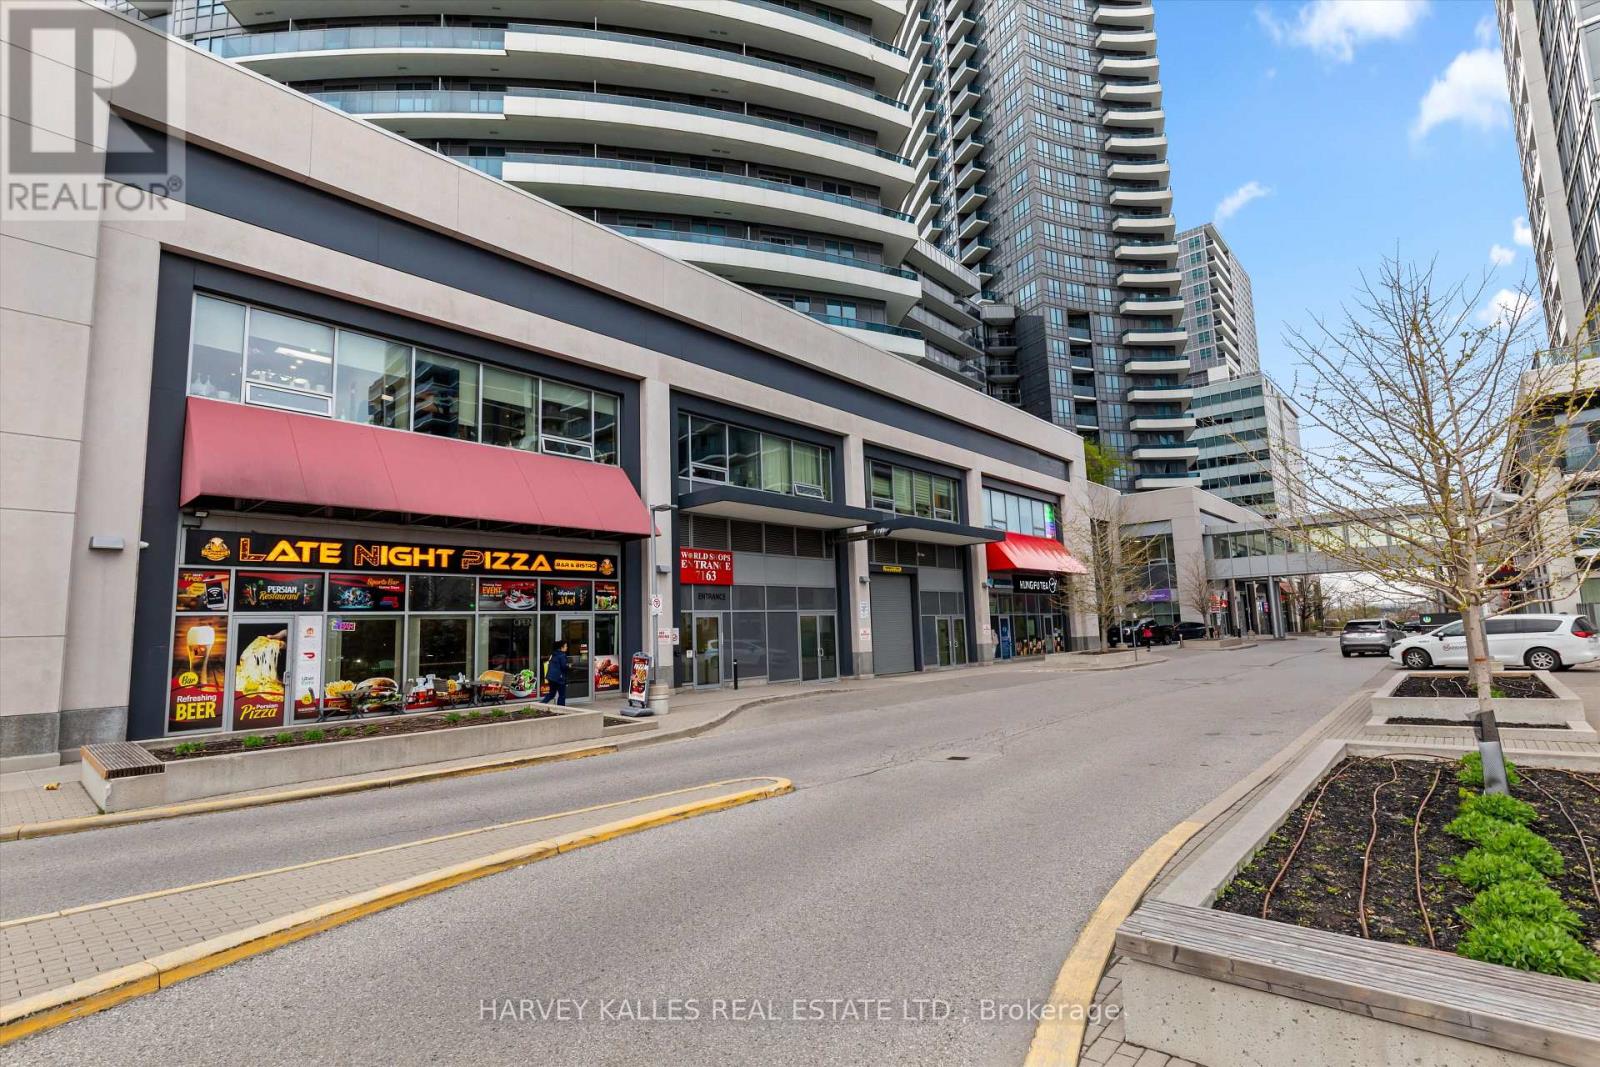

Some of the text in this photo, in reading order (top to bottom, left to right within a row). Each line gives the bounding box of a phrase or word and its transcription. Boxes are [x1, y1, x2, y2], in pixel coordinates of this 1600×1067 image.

[239, 537, 343, 564] LATE
[354, 544, 456, 568] NIGHT
[461, 549, 552, 572] PIZZA
[267, 585, 298, 593] PERSIAN
[482, 587, 503, 595] EVENT
[259, 591, 301, 601] Restaurant
[698, 592, 726, 601] ENTRANCE
[176, 694, 217, 703] Refreshing
[175, 701, 217, 721] BEER
[240, 704, 278, 720] Pizza
